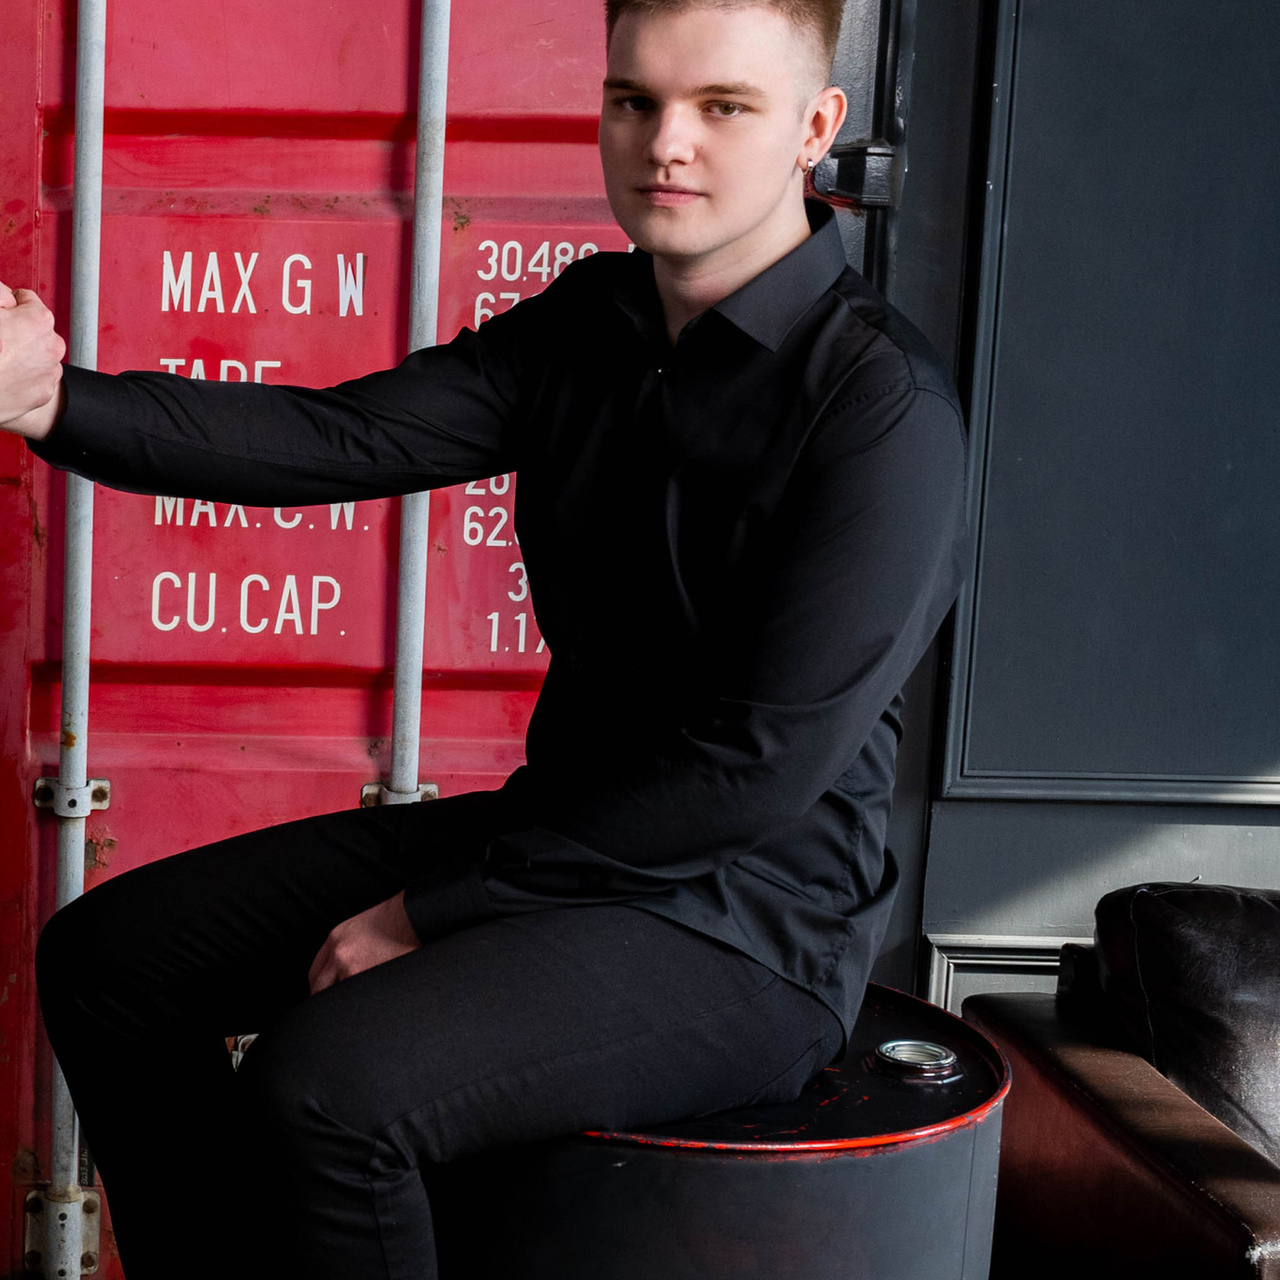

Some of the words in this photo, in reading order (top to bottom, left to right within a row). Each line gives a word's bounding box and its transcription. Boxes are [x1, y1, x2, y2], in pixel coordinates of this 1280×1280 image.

[161, 250, 260, 315] MAX
[281, 253, 313, 315] G
[336, 252, 366, 318] W
